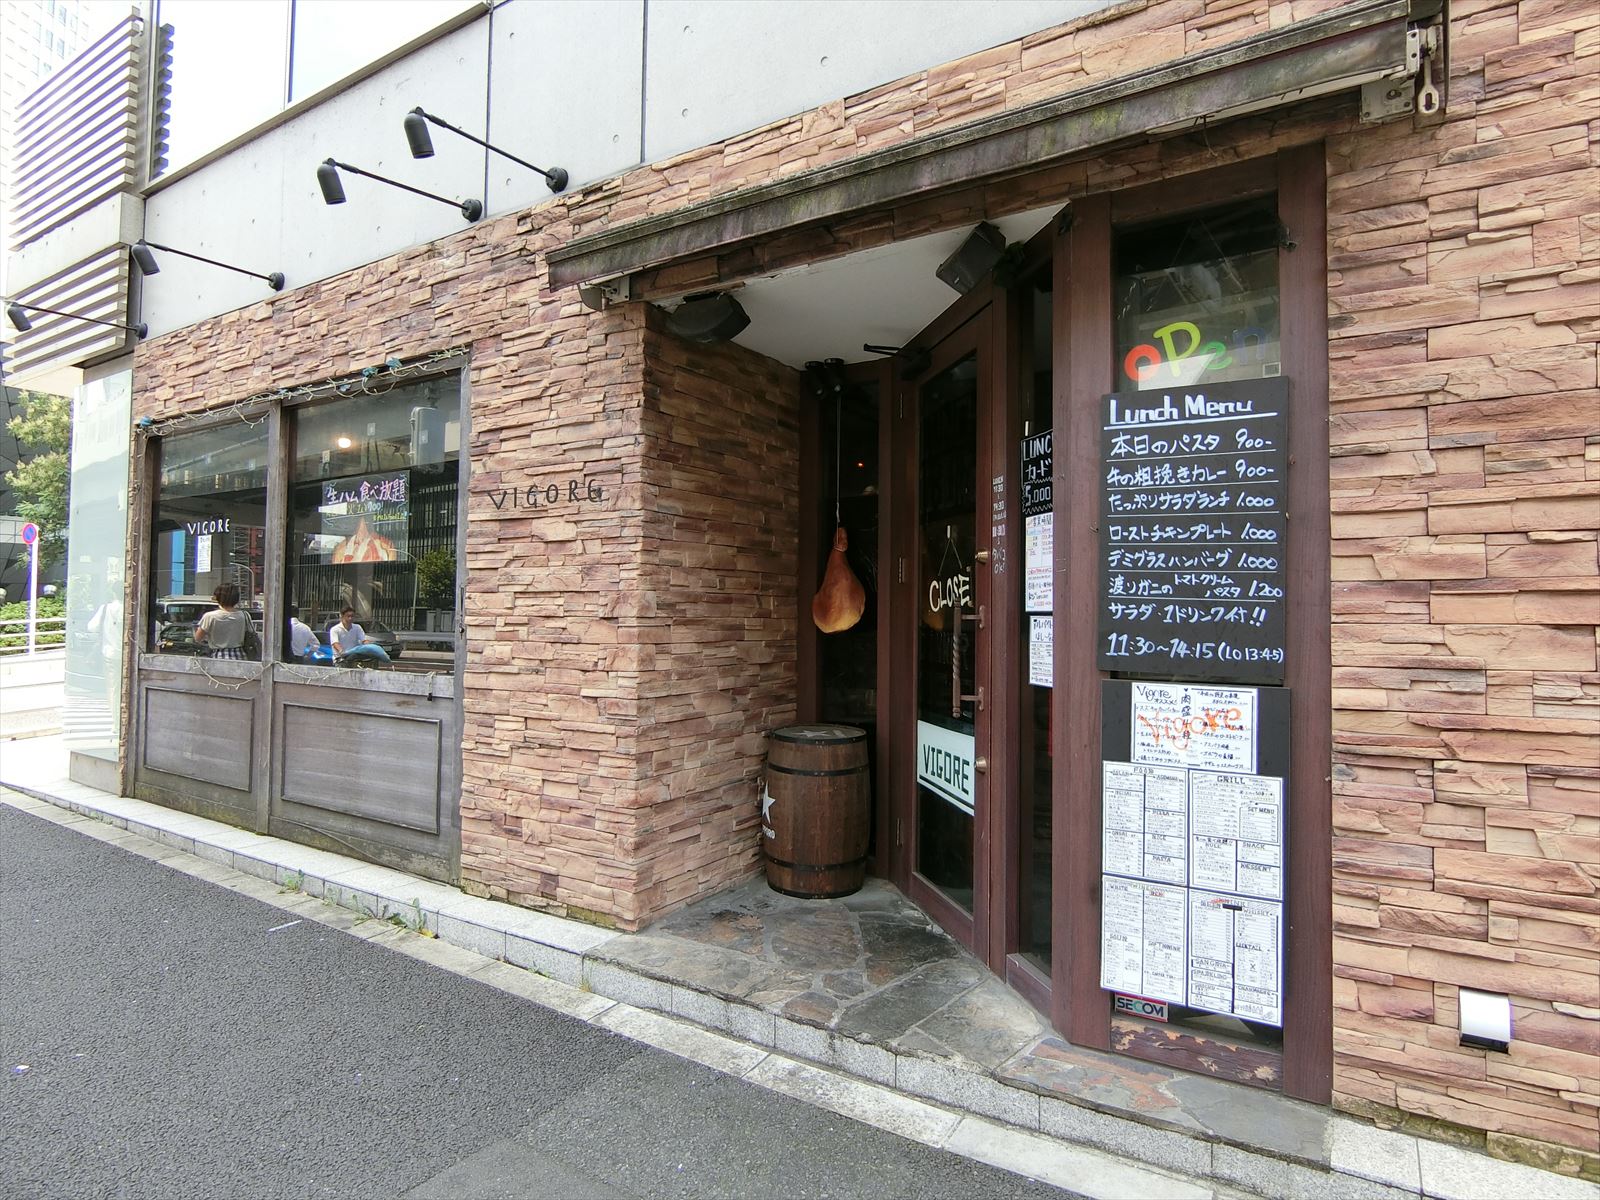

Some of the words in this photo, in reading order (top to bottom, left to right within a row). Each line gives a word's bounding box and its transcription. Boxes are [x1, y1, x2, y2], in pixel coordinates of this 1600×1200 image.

[1109, 395, 1179, 425] Lunch
[1185, 394, 1253, 418] Menu
[1023, 433, 1053, 461] LUNC
[1110, 431, 1220, 458] 本日のパスタ
[1106, 463, 1227, 487] 牛の粗挽きカレー
[326, 478, 406, 505] 生ハム食べ放題
[1108, 490, 1230, 512] たっぷりサラダランチ
[187, 518, 231, 535] VIGORE
[1108, 522, 1232, 542] ローストチキンプレート
[1108, 548, 1233, 568] デミグラスハンバーグ
[929, 574, 970, 613] CLOSE
[1108, 573, 1174, 596] 渡りガニの
[1174, 573, 1235, 586] トマトクリーム
[1204, 586, 1241, 599] パスタ
[1136, 685, 1172, 702] Vigore
[923, 743, 970, 796] VIGORE
[1217, 775, 1246, 785] GRILL
[1117, 998, 1164, 1018] SECOM
